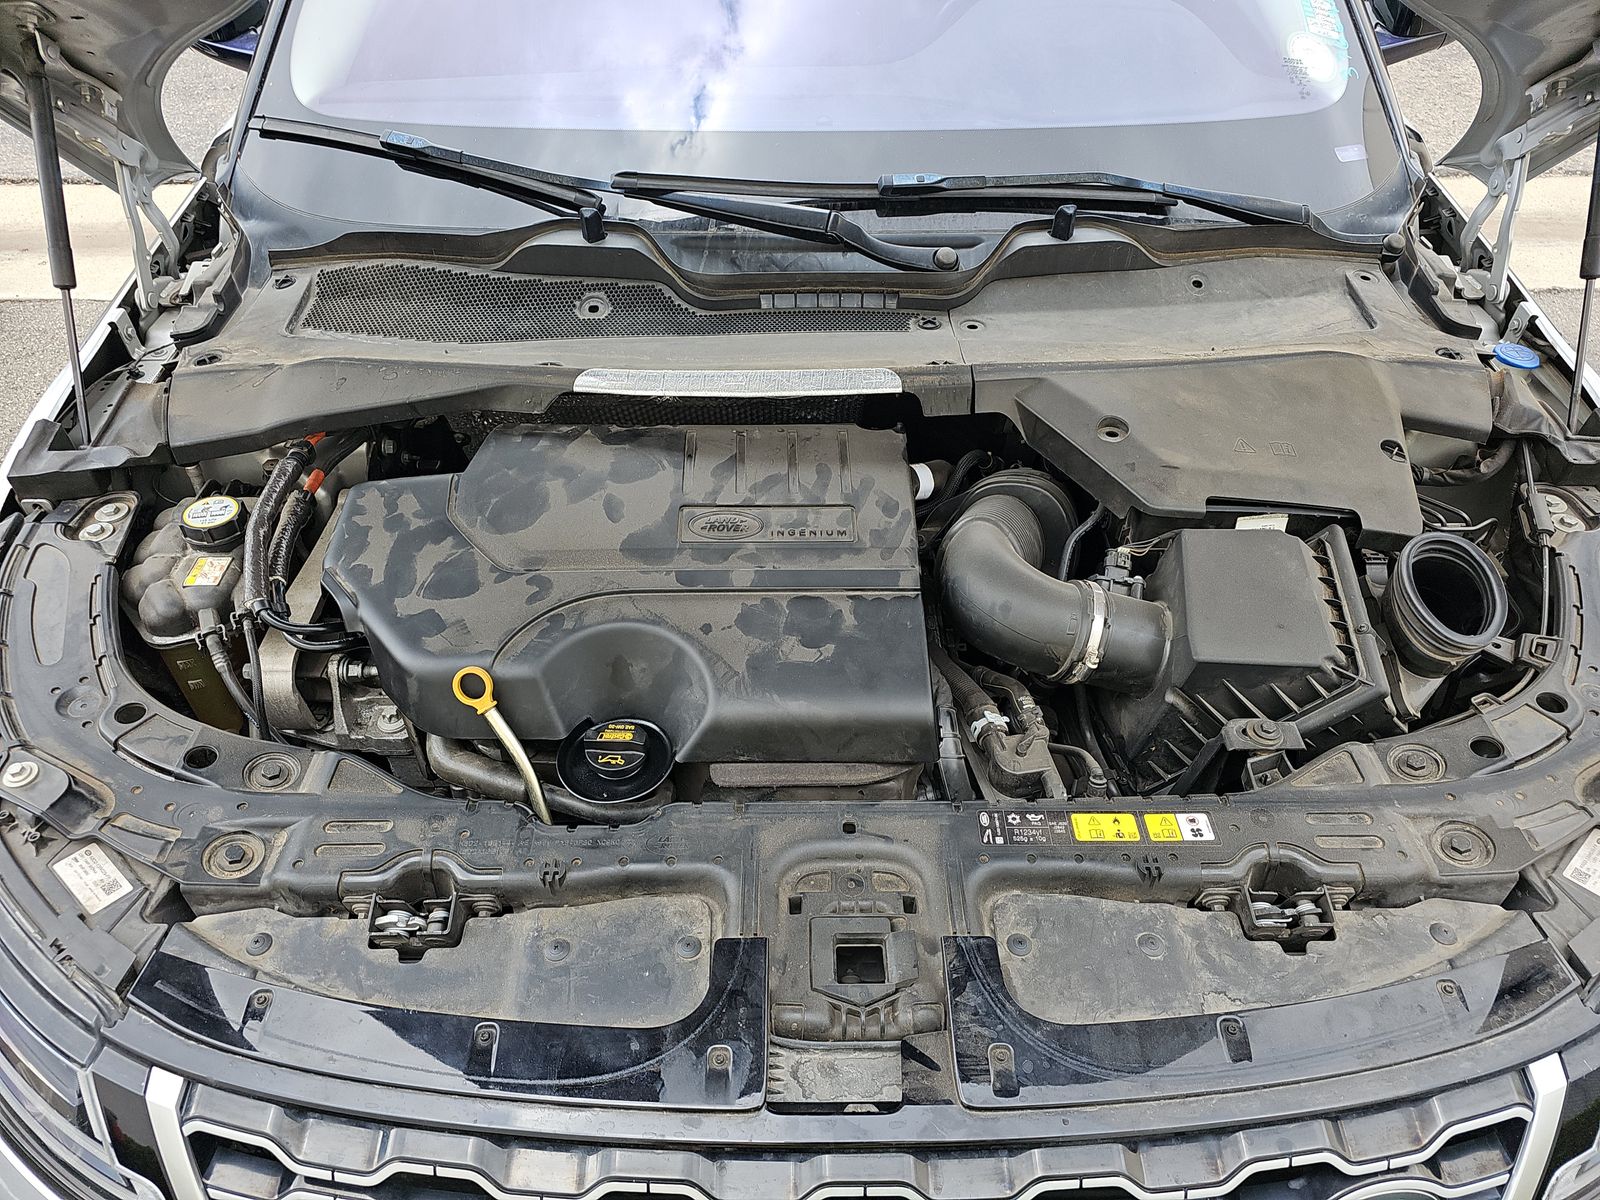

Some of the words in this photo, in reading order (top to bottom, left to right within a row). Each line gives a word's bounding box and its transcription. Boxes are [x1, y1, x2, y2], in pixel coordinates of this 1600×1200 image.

[704, 516, 739, 525] LAND
[707, 524, 750, 533] ROVER
[770, 528, 848, 537] INGENIUM
